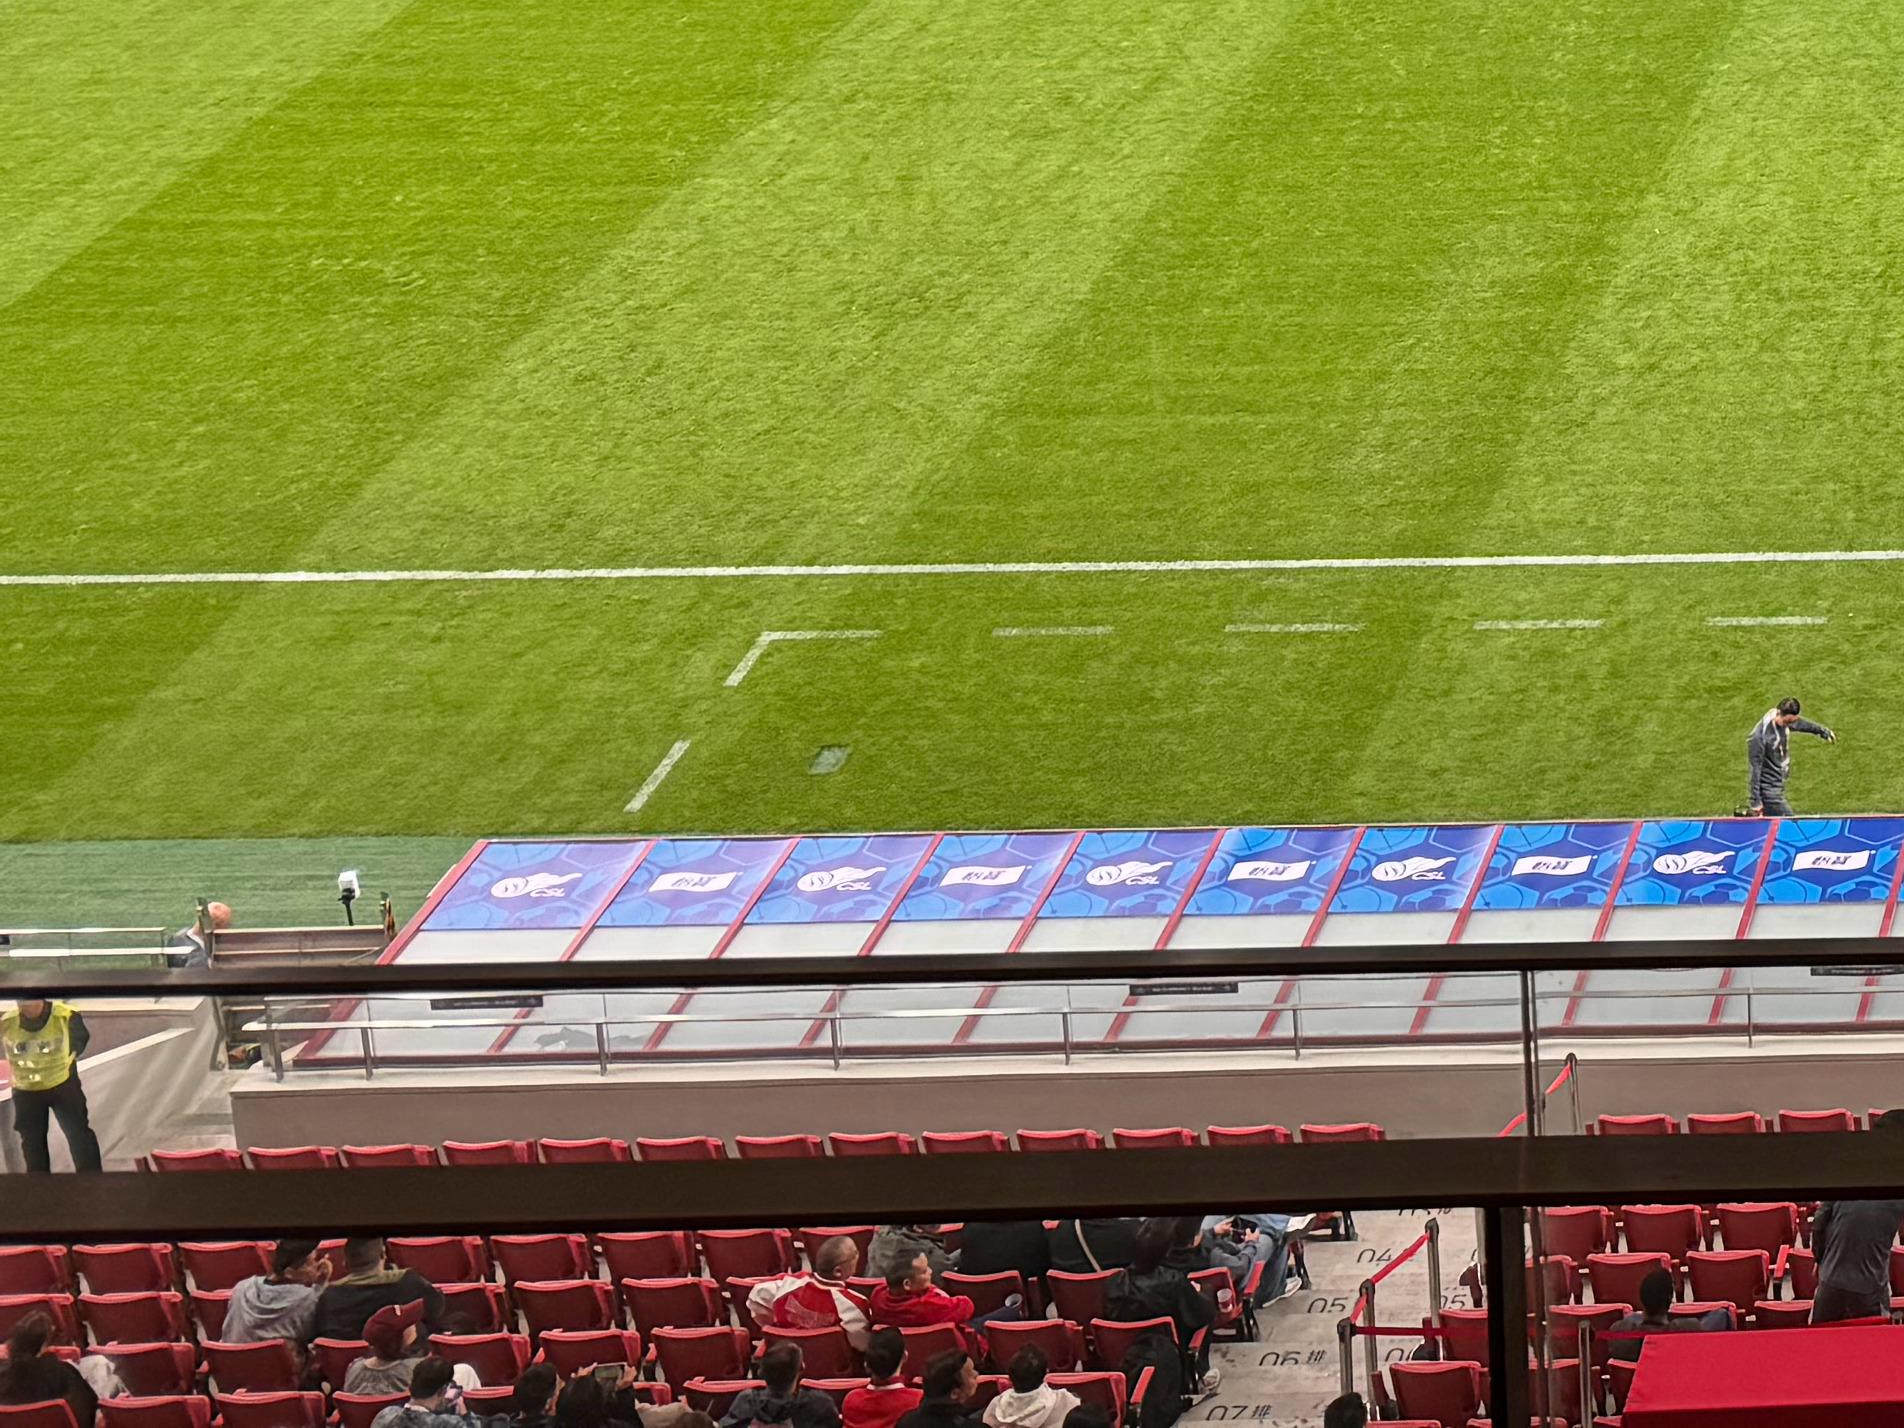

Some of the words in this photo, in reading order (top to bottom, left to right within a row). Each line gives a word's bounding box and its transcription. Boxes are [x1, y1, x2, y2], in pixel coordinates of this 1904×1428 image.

[1693, 864, 1727, 875] CSL
[1125, 875, 1159, 885] CSL
[1412, 870, 1446, 881] CSL
[530, 886, 566, 897] CSL
[836, 881, 872, 891] CSL
